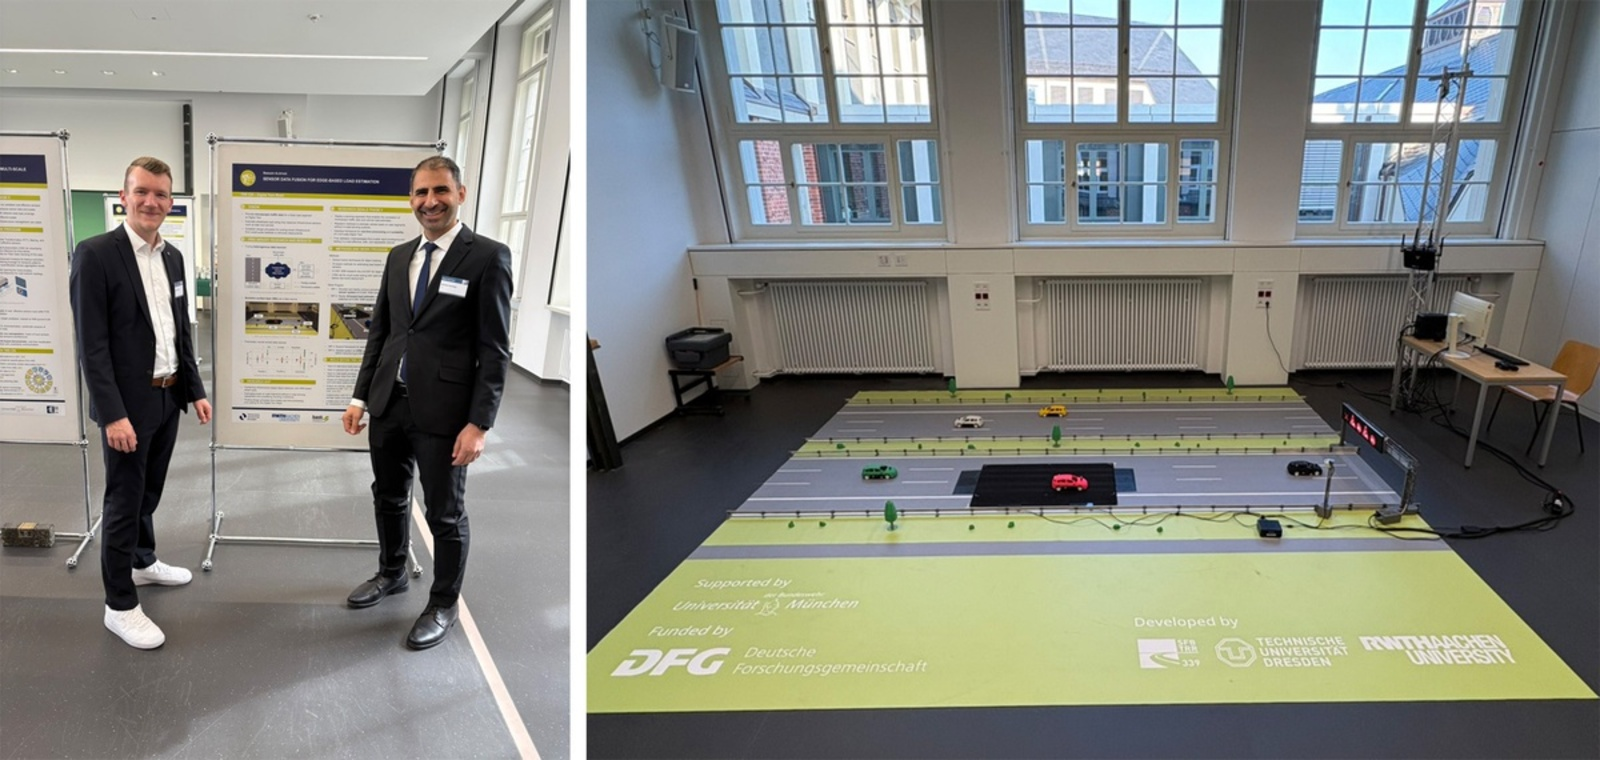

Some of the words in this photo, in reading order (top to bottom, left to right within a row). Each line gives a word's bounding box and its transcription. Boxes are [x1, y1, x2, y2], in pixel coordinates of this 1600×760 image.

[694, 579, 769, 590] Supported
[773, 578, 792, 589] by
[672, 599, 761, 611] Universität
[784, 598, 859, 609] München
[1134, 616, 1216, 629] Developed
[1220, 616, 1239, 629] by
[648, 625, 710, 637] Funded
[712, 625, 734, 638] by
[1255, 637, 1345, 647] TECHNISCHE
[744, 646, 817, 658] Deutsche
[1259, 645, 1349, 656] UNIVERSITÄT
[610, 647, 732, 677] DFG
[1181, 659, 1200, 667] 339
[1262, 657, 1332, 667] DRESDEN
[1405, 649, 1516, 665] UNIVERSITY
[732, 659, 928, 677] Forschungsgemeinschaft
